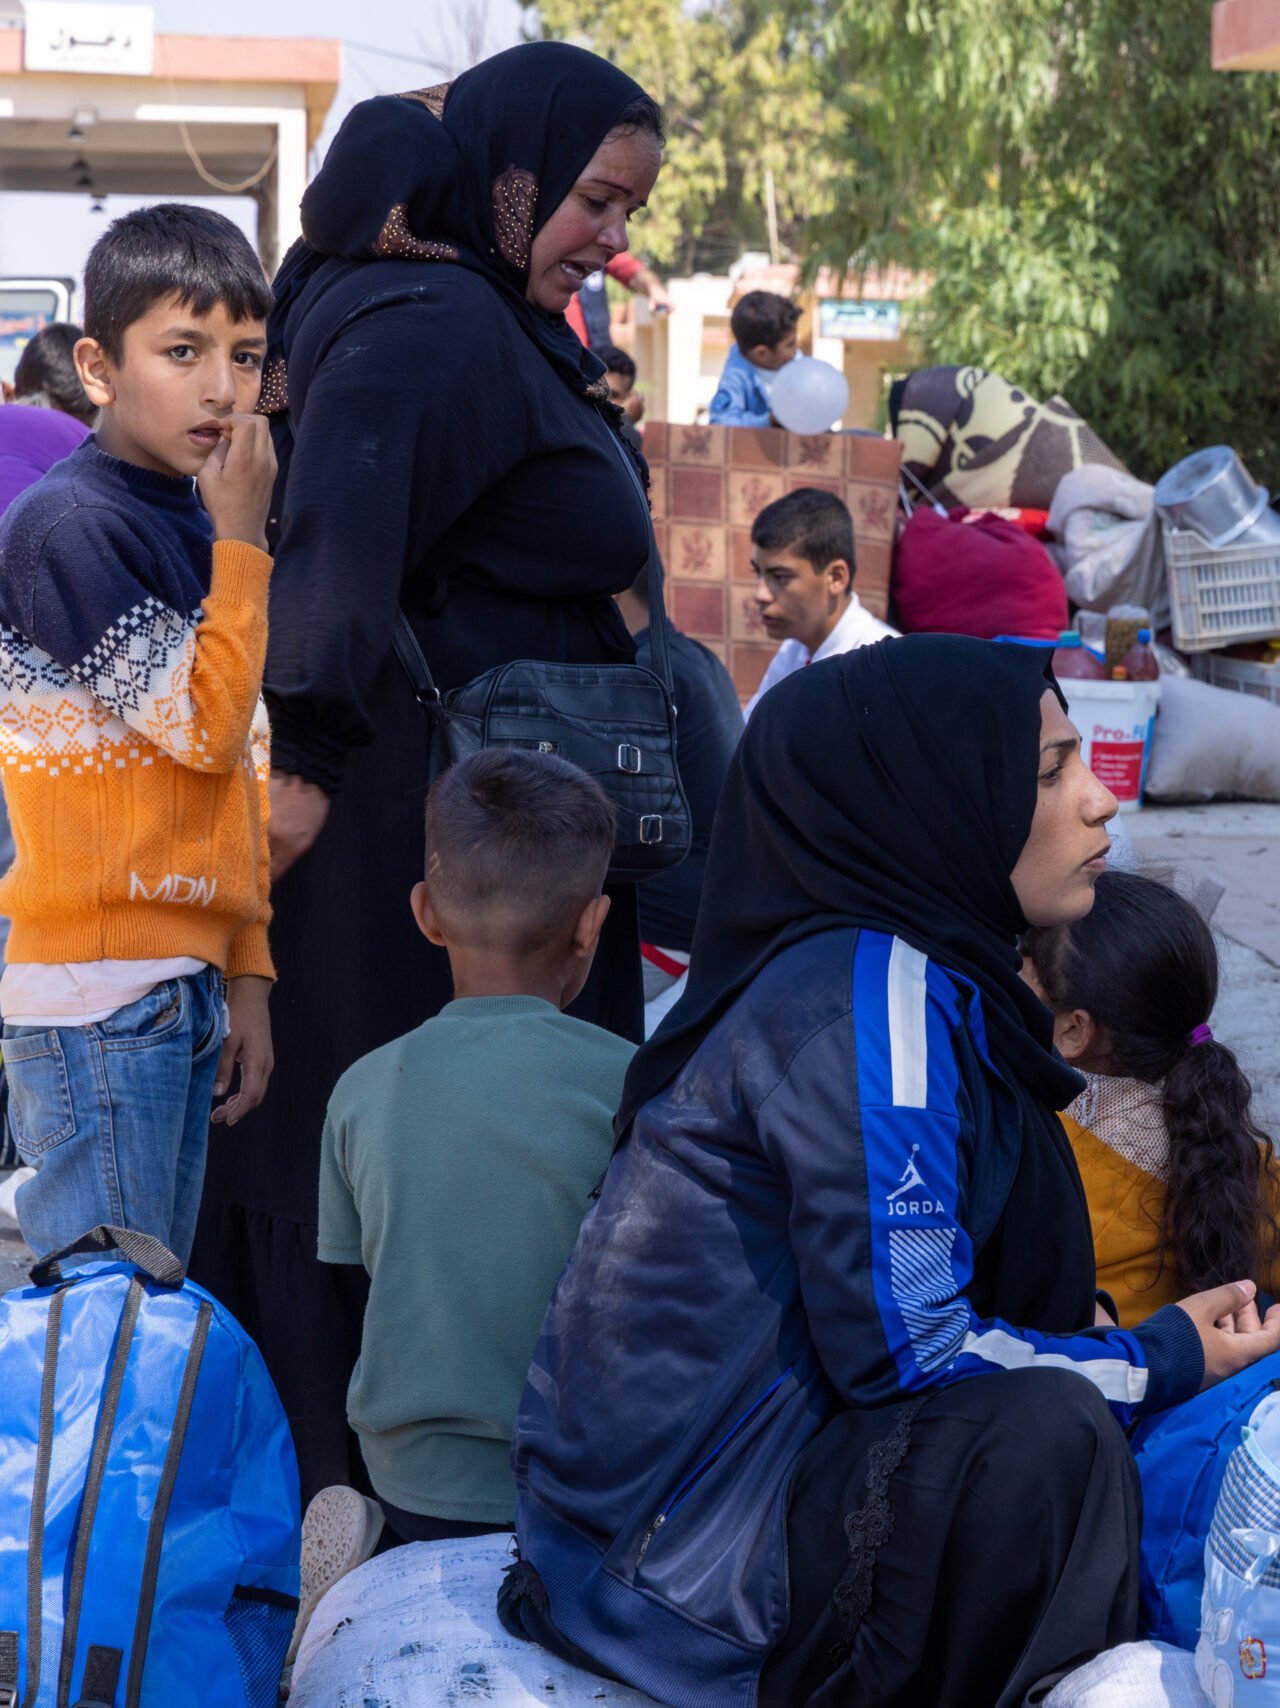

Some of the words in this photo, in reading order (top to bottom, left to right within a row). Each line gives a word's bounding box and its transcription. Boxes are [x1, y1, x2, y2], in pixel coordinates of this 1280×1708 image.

[49, 28, 132, 51] دخول
[128, 871, 217, 908] MDN
[888, 1199, 945, 1216] JORDA
